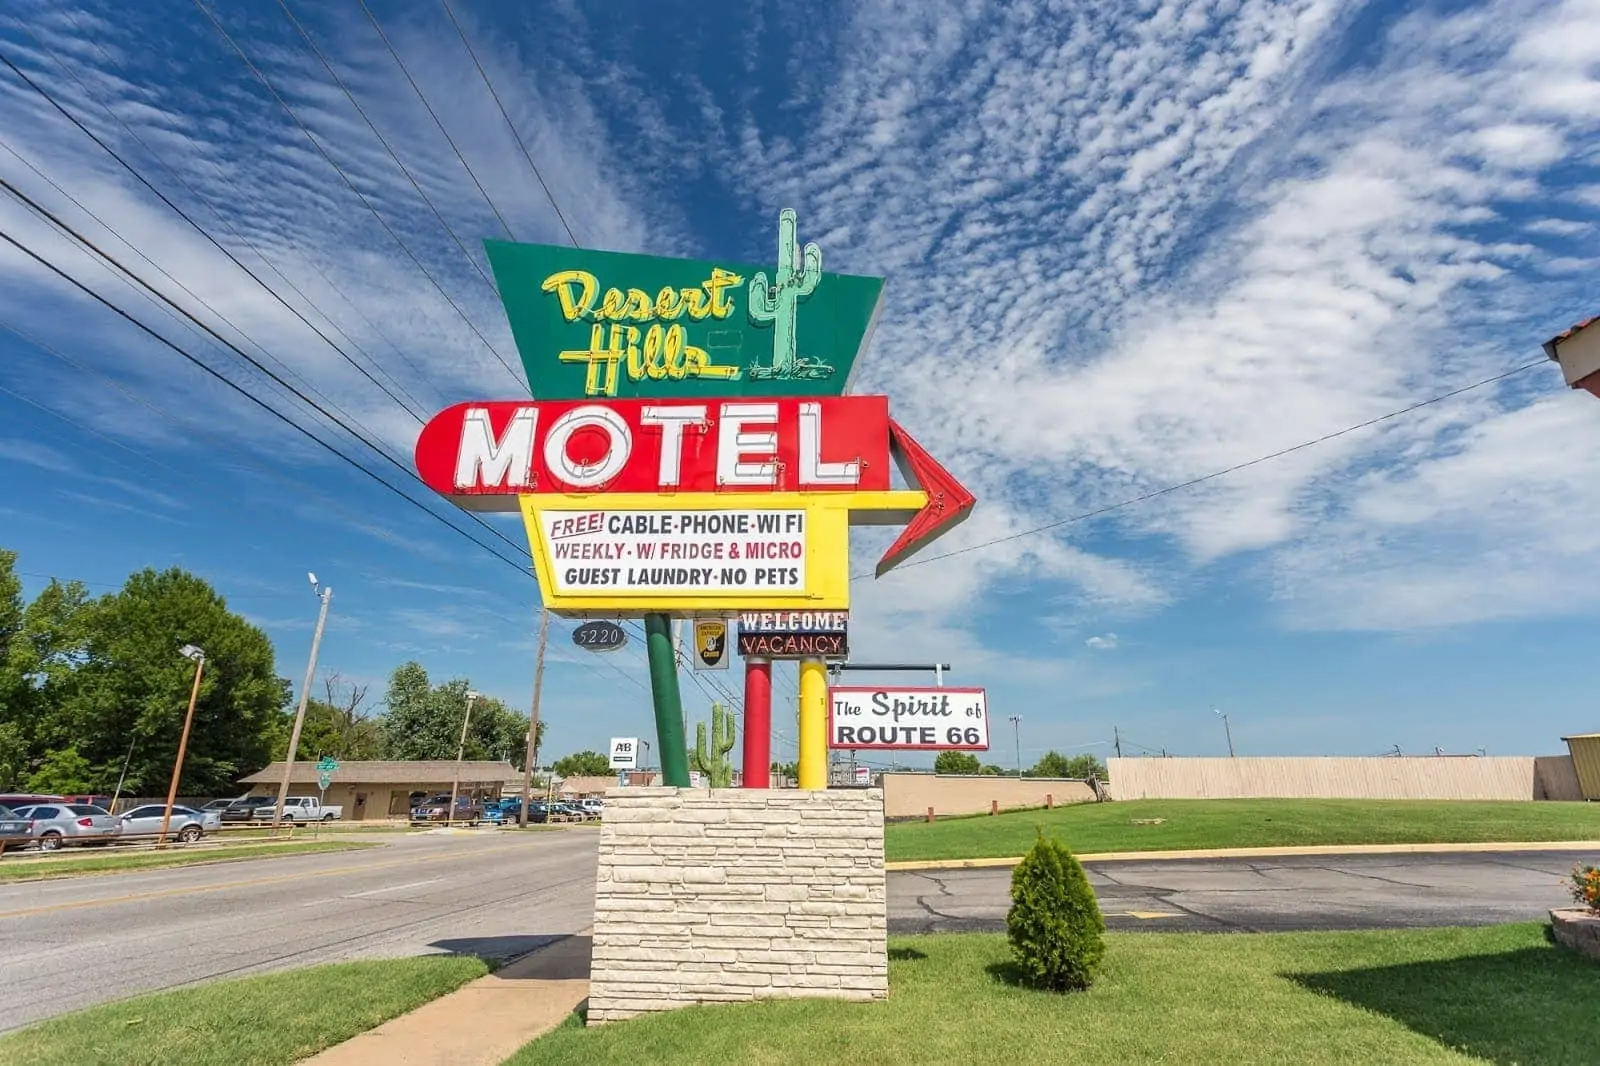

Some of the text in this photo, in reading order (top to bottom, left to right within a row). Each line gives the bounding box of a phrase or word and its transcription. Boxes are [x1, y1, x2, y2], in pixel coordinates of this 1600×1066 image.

[541, 268, 744, 321] Desert
[558, 323, 742, 396] Hills
[454, 403, 864, 488] MOTEL
[551, 512, 605, 537] FREE!
[555, 543, 625, 560] WEEKLY
[660, 542, 724, 560] FRIDGE
[728, 542, 740, 560] &
[745, 541, 802, 560] MICRO
[565, 567, 799, 585] GUEST LAUNDRY NO PETS
[740, 611, 845, 631] WELCOME
[580, 629, 618, 643] 5220
[741, 636, 841, 653] VACANCY
[835, 692, 981, 722] The Spirit of
[838, 727, 980, 744] ROUTE 66
